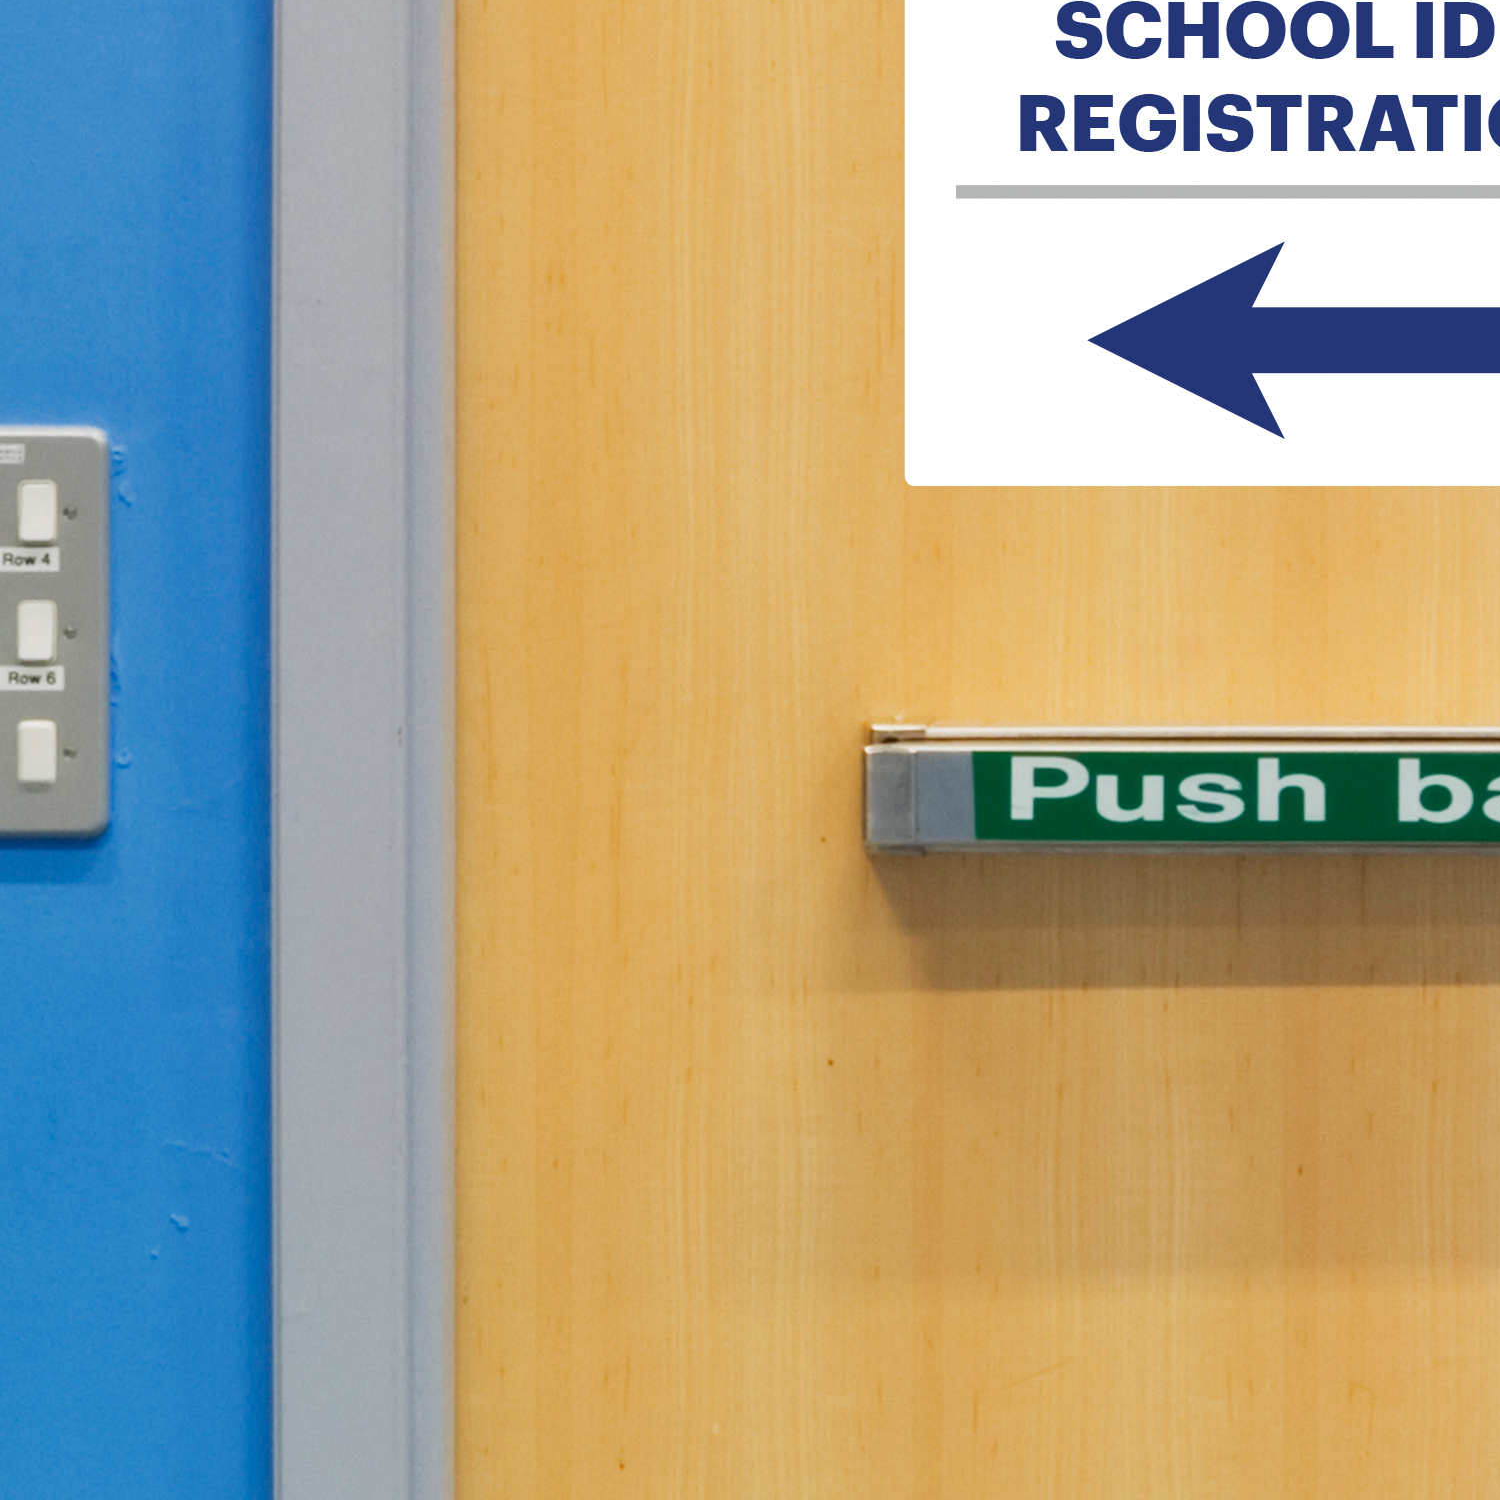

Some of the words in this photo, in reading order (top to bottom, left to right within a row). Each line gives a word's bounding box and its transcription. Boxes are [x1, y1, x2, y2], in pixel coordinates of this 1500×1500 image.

[1055, 0, 1394, 60] SCHOOL
[1416, 1, 1495, 59] ID
[3, 552, 37, 566] Row
[41, 552, 51, 566] 4
[8, 670, 42, 685] Row
[46, 670, 57, 685] 6
[1010, 755, 1326, 823] Push
